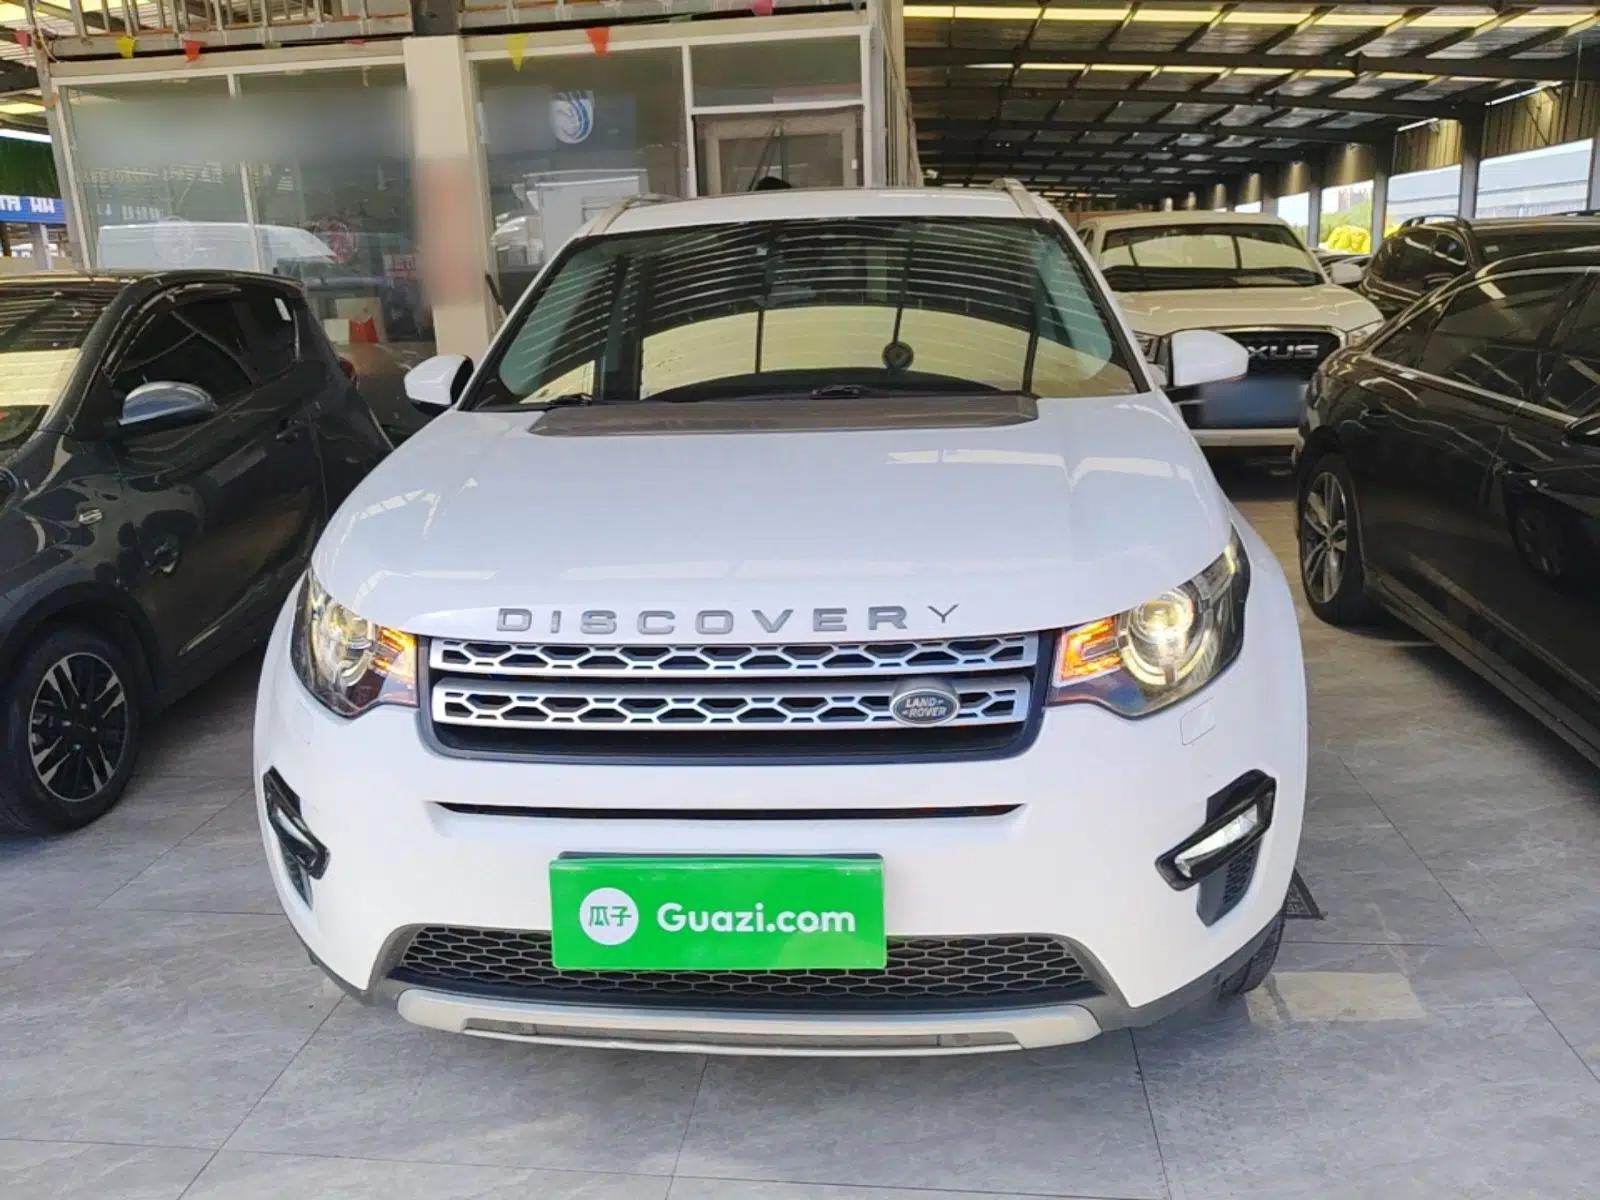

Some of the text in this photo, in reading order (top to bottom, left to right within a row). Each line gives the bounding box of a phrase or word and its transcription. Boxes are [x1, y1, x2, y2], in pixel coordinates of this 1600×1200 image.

[496, 604, 959, 635] DISCOVERY
[905, 697, 937, 708] LAND
[908, 706, 947, 718] ROVER
[588, 905, 632, 927] 瓜子
[656, 901, 856, 933] Guazi.com
